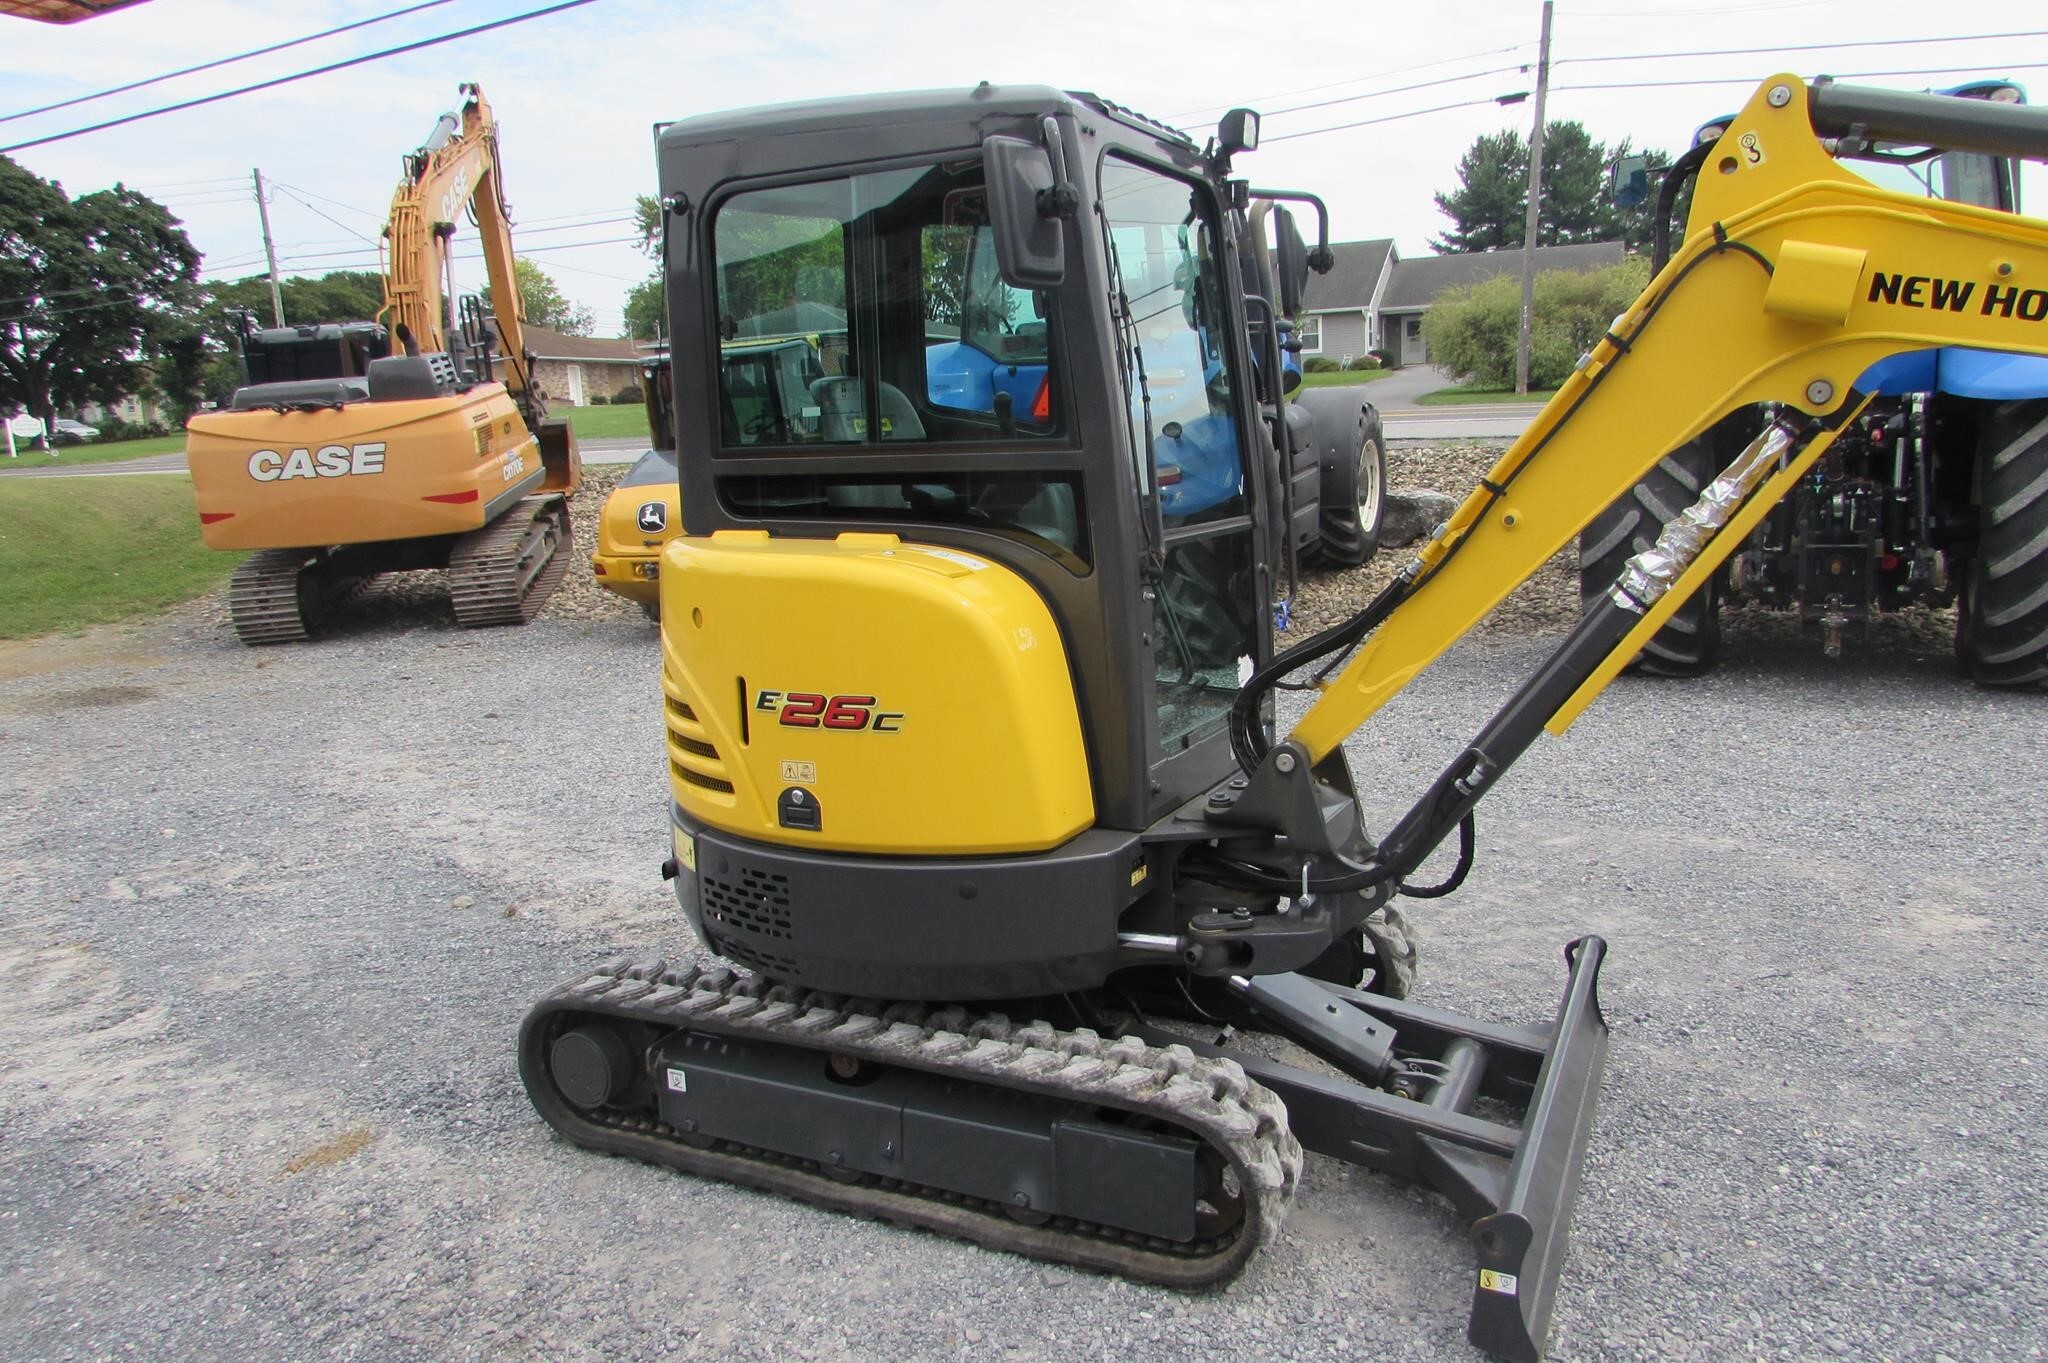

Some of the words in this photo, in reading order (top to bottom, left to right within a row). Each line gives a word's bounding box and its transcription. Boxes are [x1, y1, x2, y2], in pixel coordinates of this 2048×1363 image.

[441, 165, 468, 221] CASE
[1867, 271, 1976, 313] NEW
[248, 442, 386, 482] CASE
